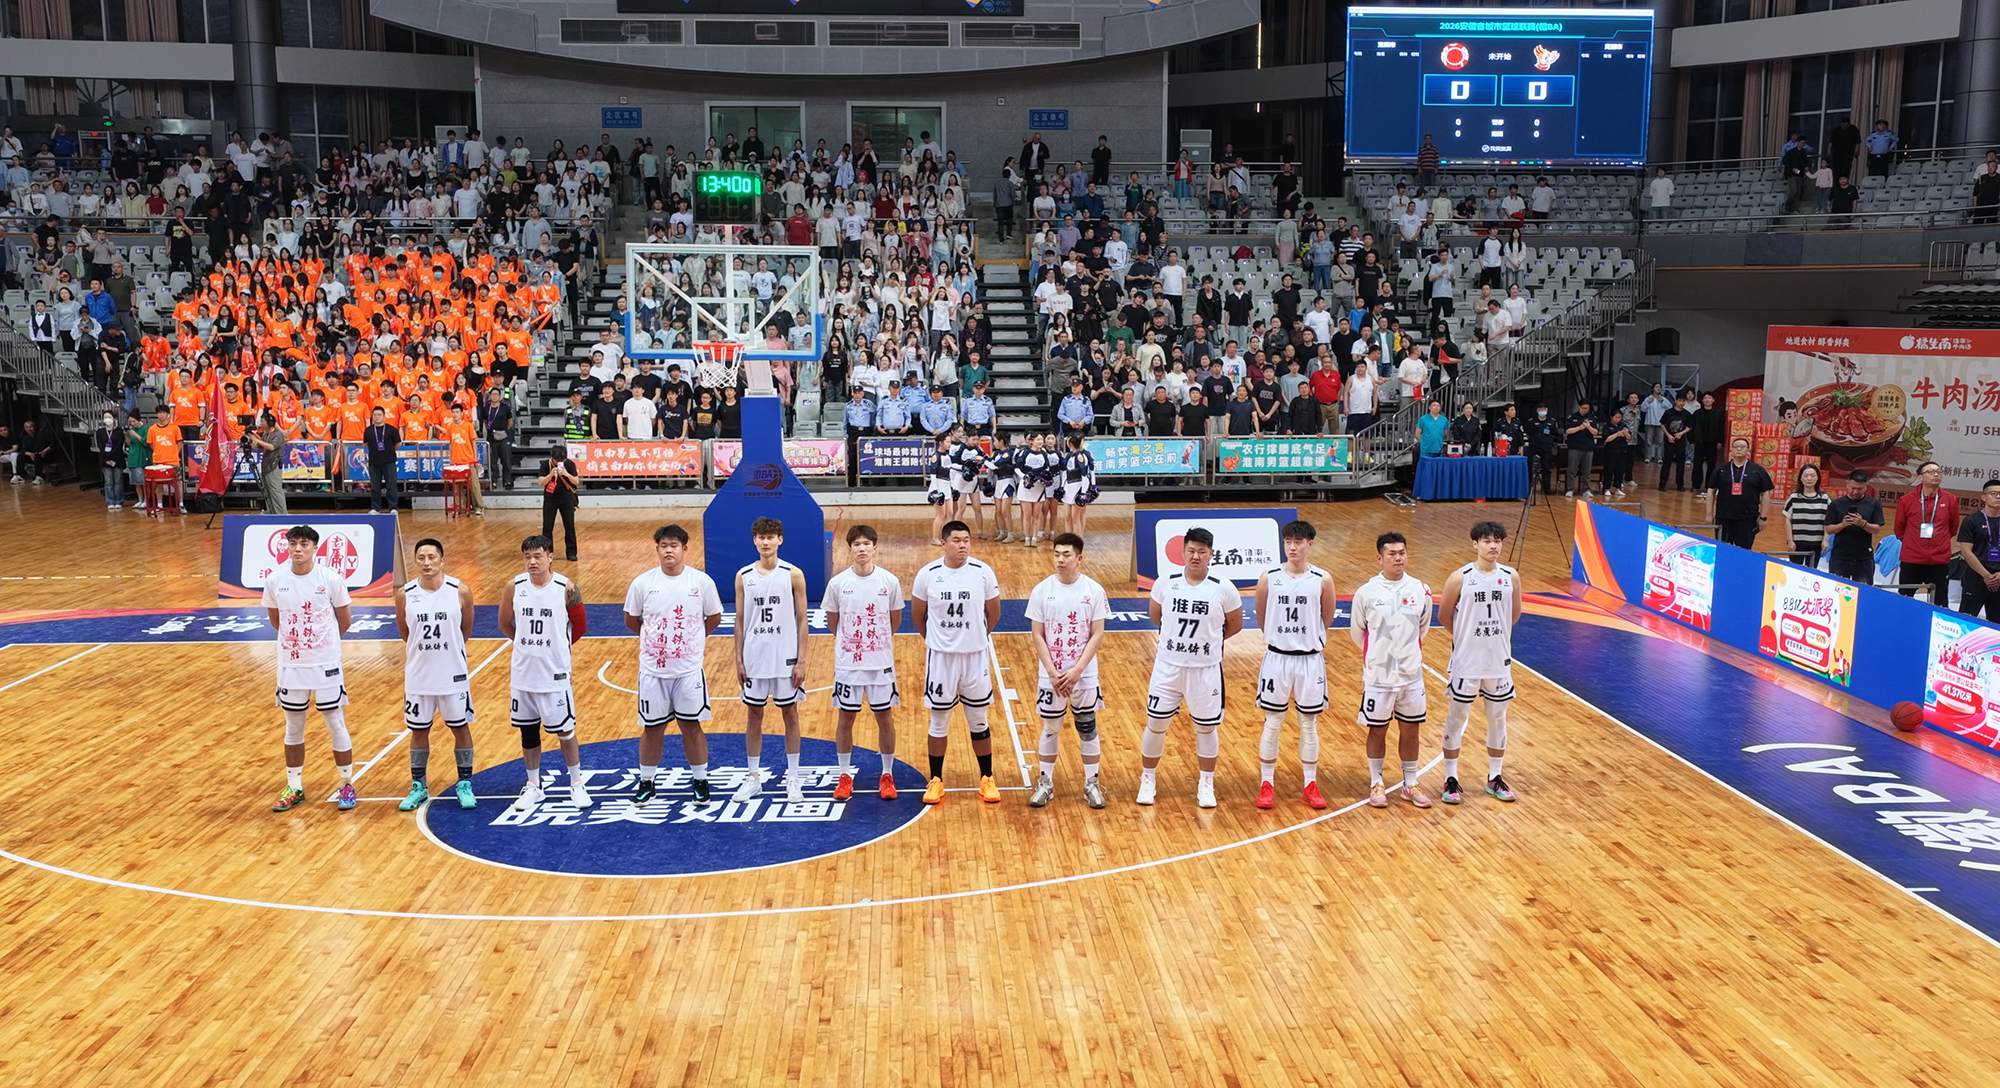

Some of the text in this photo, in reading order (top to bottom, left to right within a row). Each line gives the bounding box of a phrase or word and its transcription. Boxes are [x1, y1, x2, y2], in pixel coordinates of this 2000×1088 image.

[1451, 81, 1547, 100] 0 0
[1911, 377, 2000, 412] 牛肉汤
[1242, 443, 1326, 455] 农行撑腰底气足
[754, 596, 780, 606] 淮南
[941, 591, 970, 601] 淮南
[1278, 595, 1307, 605] 淮南
[1474, 591, 1502, 602] 淮南
[522, 607, 553, 618] 淮南
[947, 603, 964, 618] 44
[1172, 597, 1210, 616] 淮南
[1486, 604, 1492, 618] 1
[417, 612, 447, 622] 淮南
[761, 608, 773, 623] 15
[1286, 607, 1299, 622] 14
[423, 624, 441, 640] 24
[530, 620, 543, 635] 10
[1178, 618, 1200, 639] 77
[929, 682, 943, 697] 44
[1261, 678, 1275, 693] 14
[1039, 688, 1054, 705] 23
[405, 701, 420, 717] 24
[510, 698, 519, 713] 0
[641, 699, 649, 714] 11
[1366, 699, 1375, 713] 9
